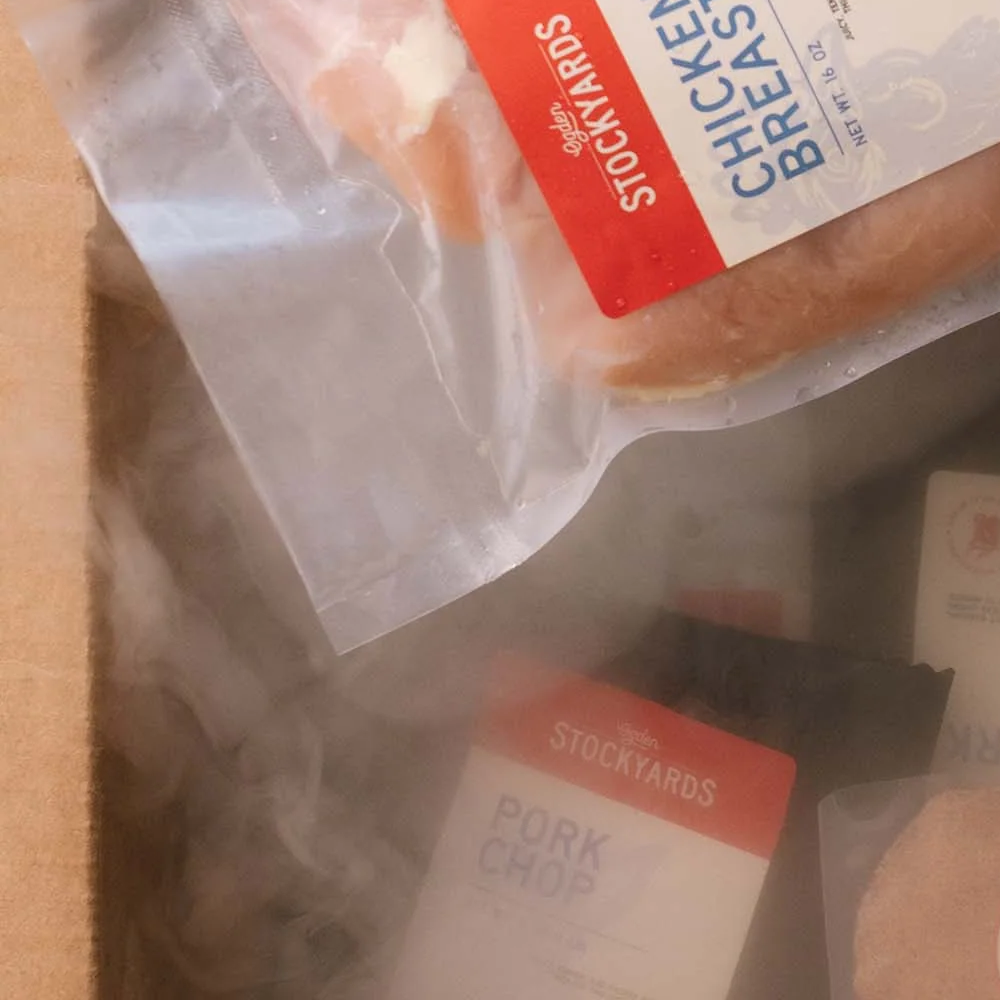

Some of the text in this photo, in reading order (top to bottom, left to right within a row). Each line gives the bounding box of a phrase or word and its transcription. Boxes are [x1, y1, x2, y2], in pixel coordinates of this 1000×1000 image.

[534, 13, 656, 214] STOCKYARDS
[548, 101, 593, 157] Ogden
[806, 39, 868, 147] NET WT. 16 OZ
[547, 720, 718, 807] STOCKYARDS
[475, 834, 597, 902] CHOP
[490, 793, 611, 869] PORK
